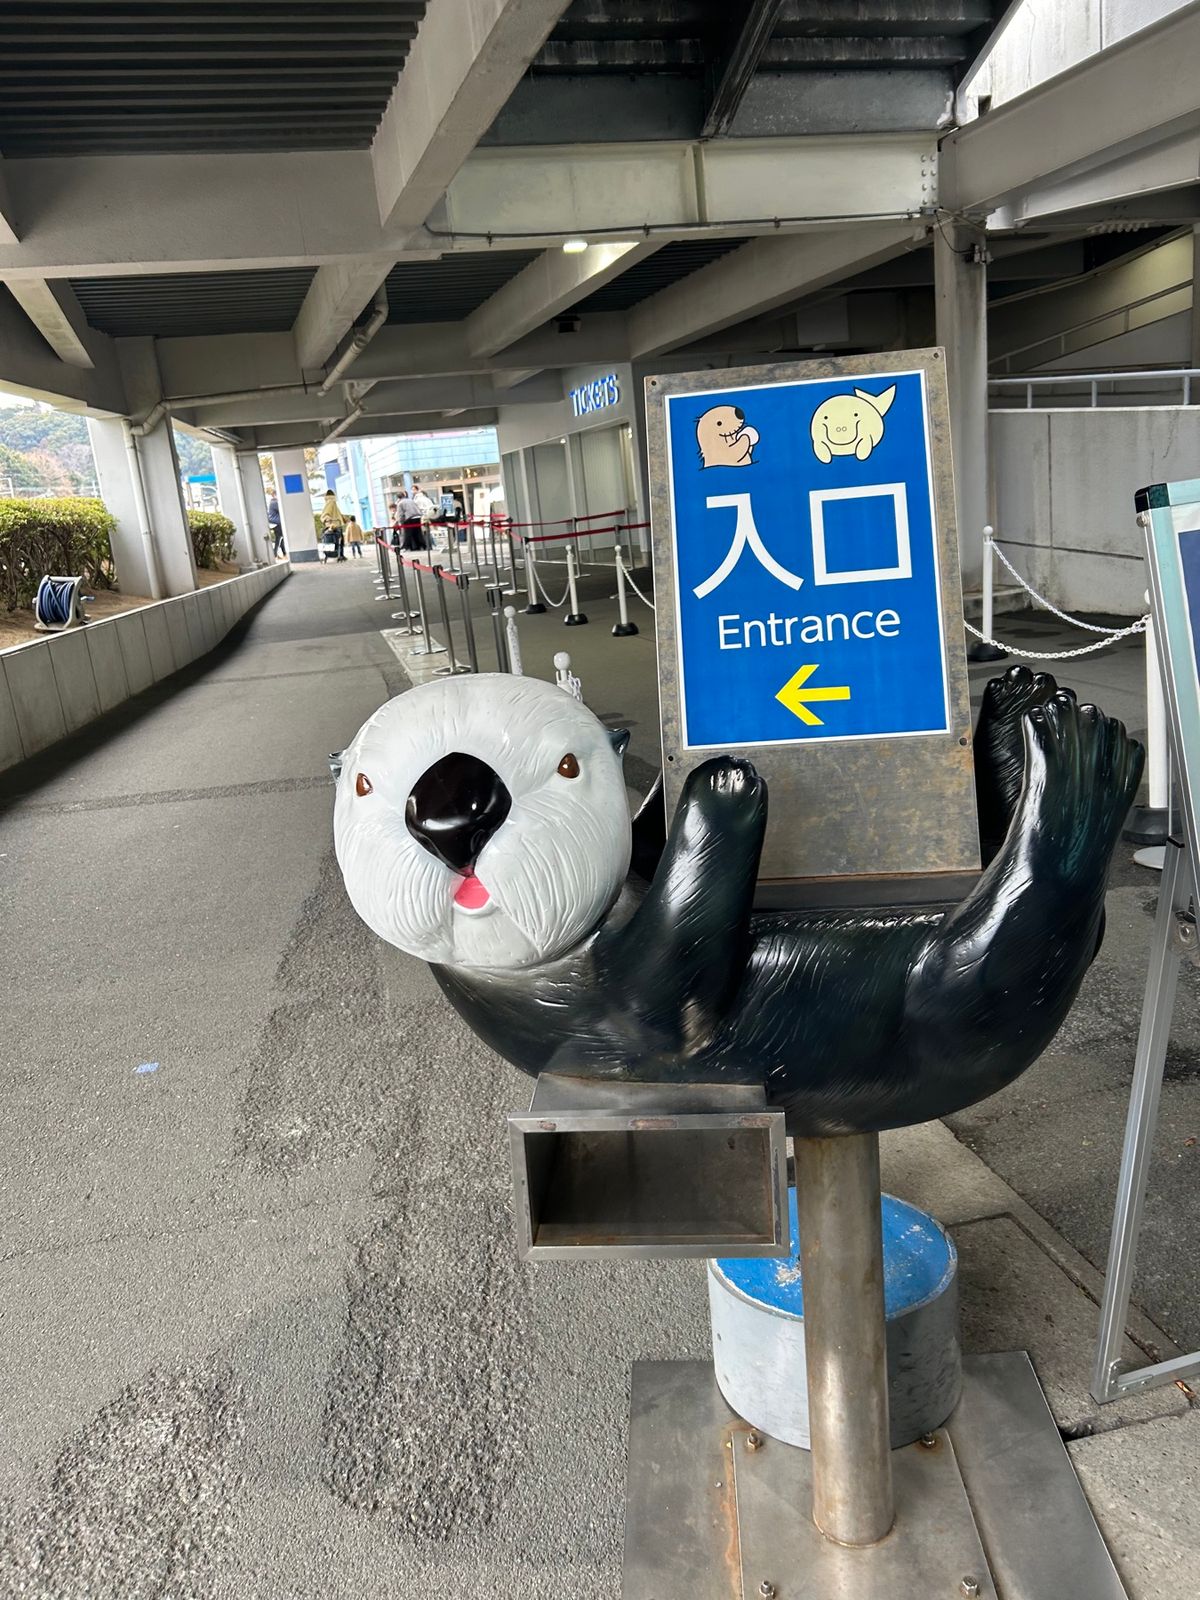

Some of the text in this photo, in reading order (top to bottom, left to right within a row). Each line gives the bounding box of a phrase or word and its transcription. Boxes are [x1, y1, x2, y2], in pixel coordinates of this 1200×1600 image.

[569, 374, 619, 417] TICKETS
[692, 482, 912, 600] 入口
[718, 608, 901, 650] Entrance
